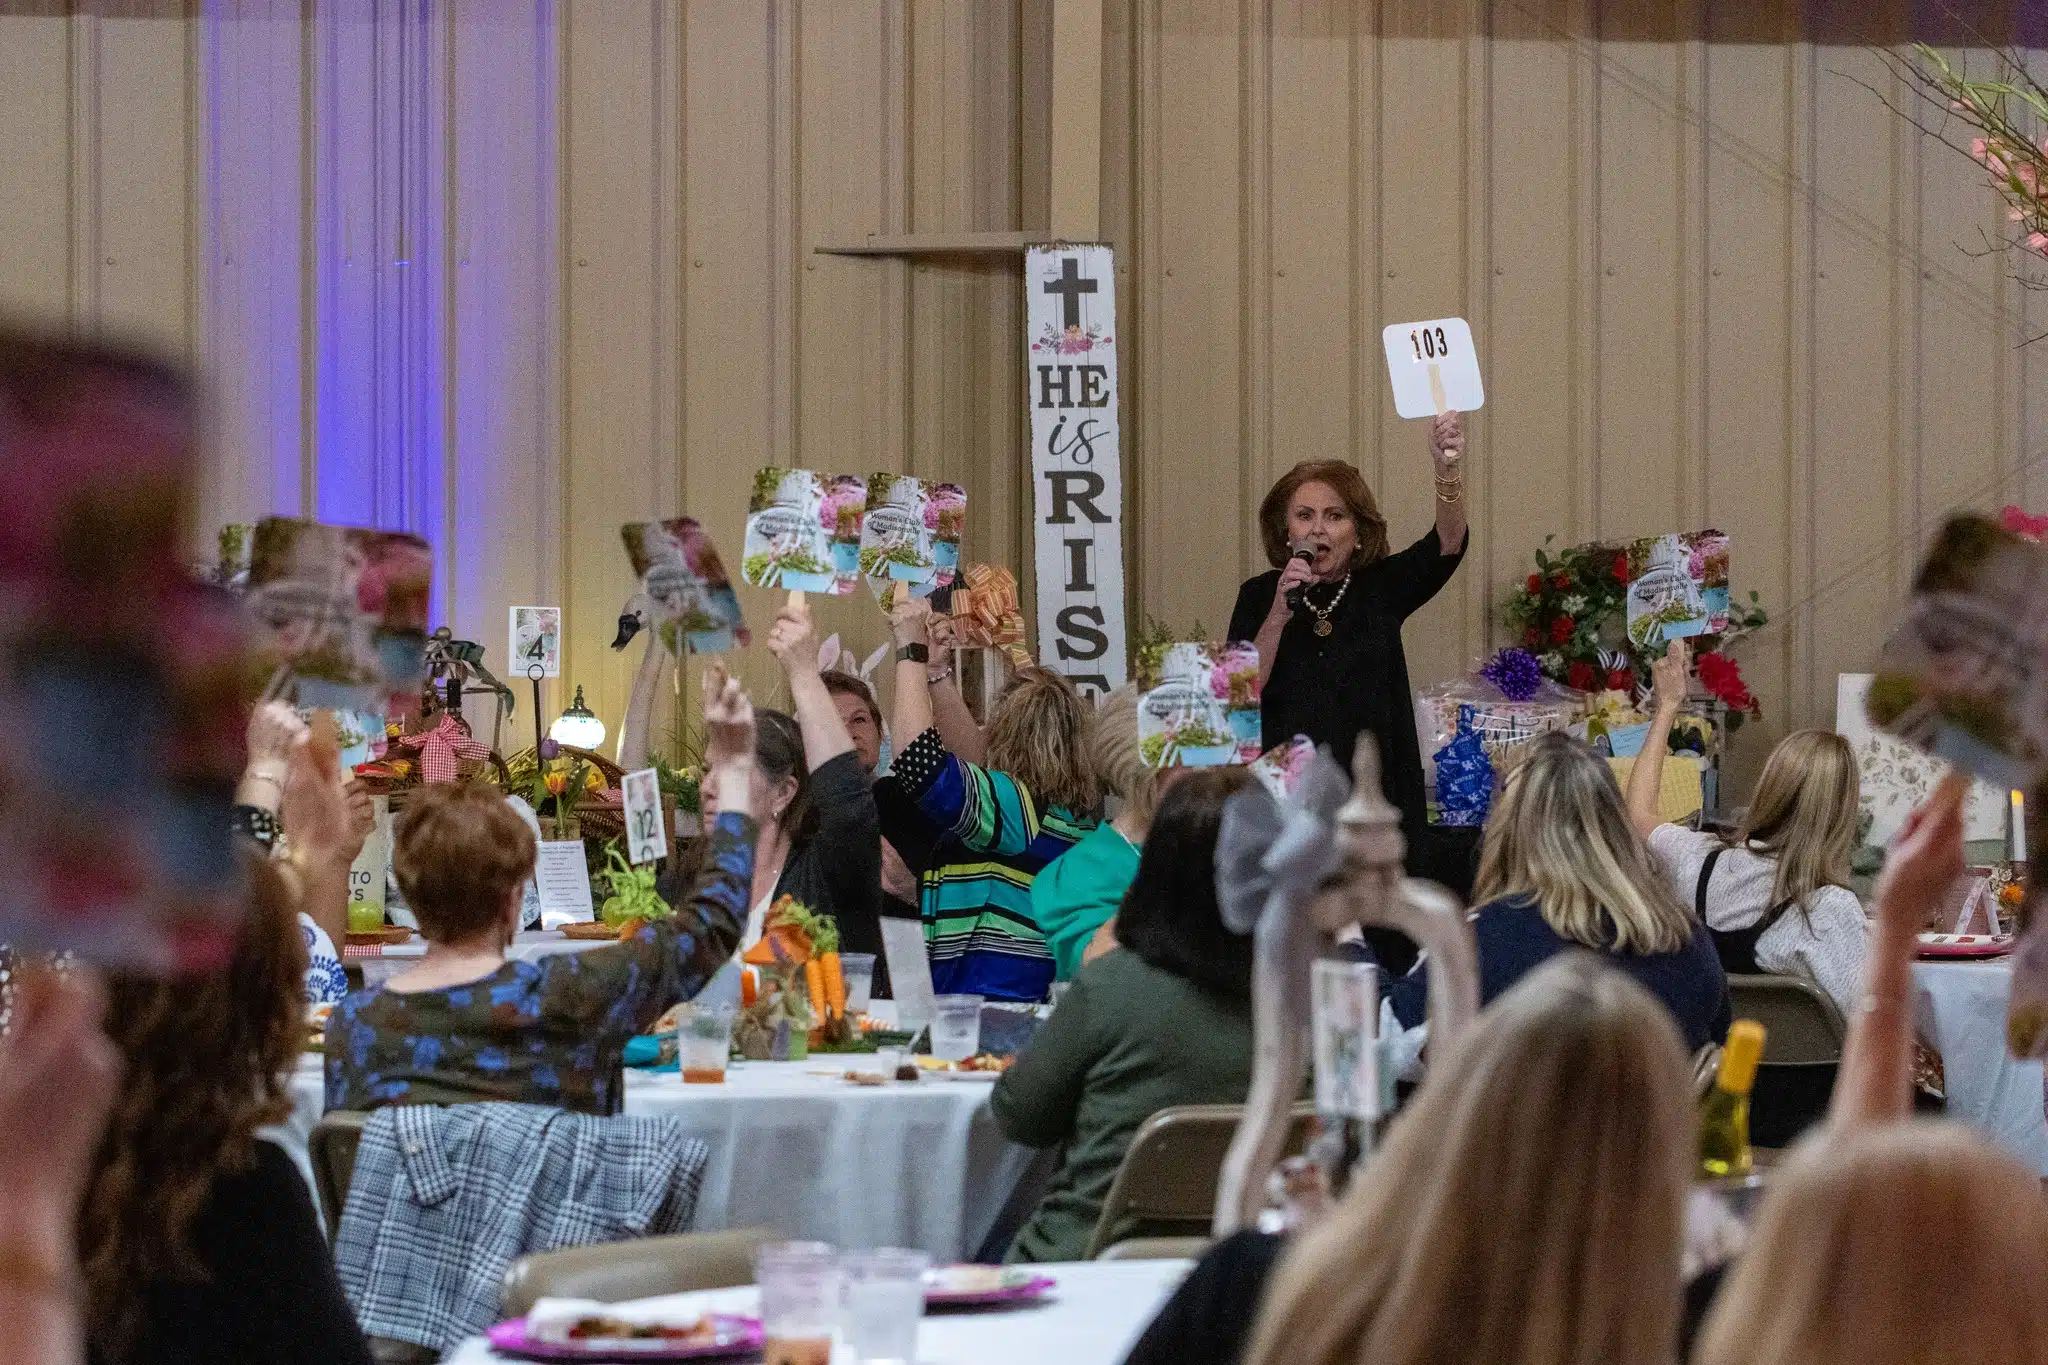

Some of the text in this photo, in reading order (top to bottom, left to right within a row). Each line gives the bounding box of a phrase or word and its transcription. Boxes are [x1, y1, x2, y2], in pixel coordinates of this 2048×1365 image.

[1410, 327, 1448, 360] 103
[1037, 364, 1110, 409] HE
[1048, 415, 1110, 465] is
[526, 632, 545, 661] 4
[633, 807, 658, 839] 12
